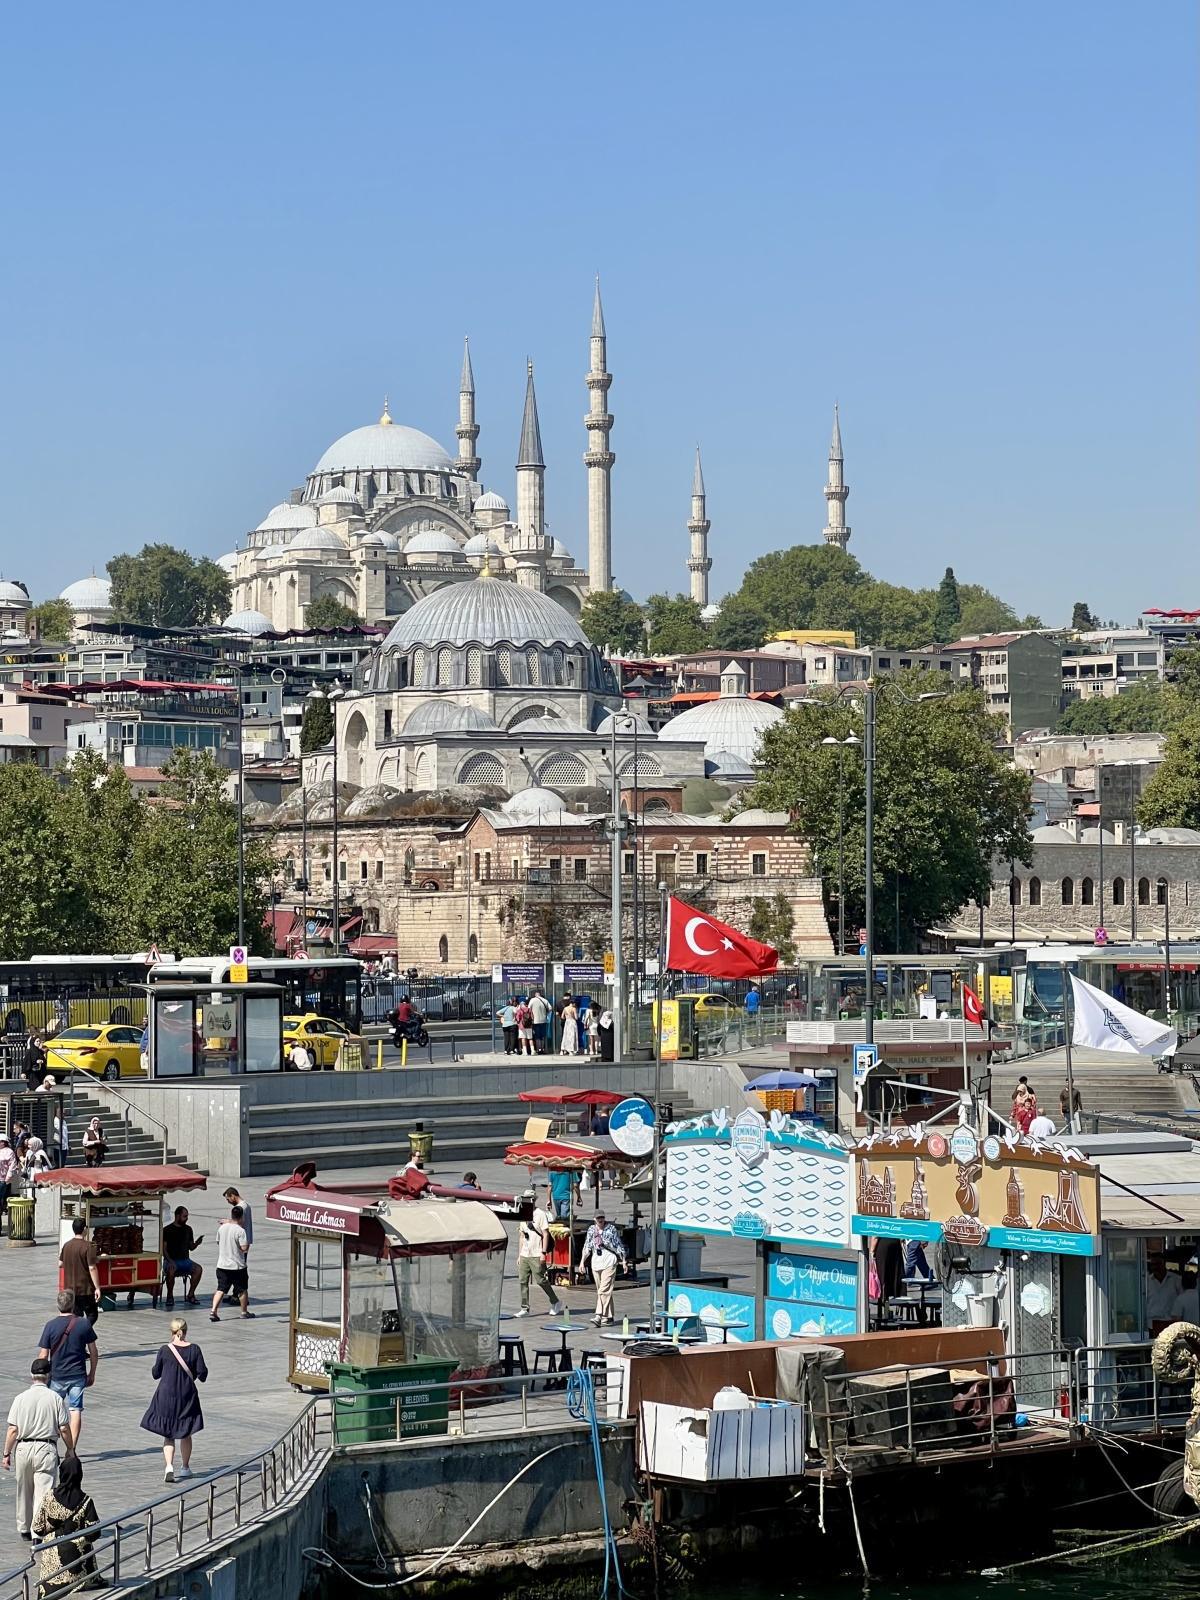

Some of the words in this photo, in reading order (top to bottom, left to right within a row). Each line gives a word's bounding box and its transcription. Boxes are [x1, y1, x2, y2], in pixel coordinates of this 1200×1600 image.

[280, 1205, 311, 1223] Osmanlı
[312, 1210, 346, 1228] Lokması
[798, 1263, 829, 1286] Afiyet
[830, 1268, 856, 1286] Olsun
